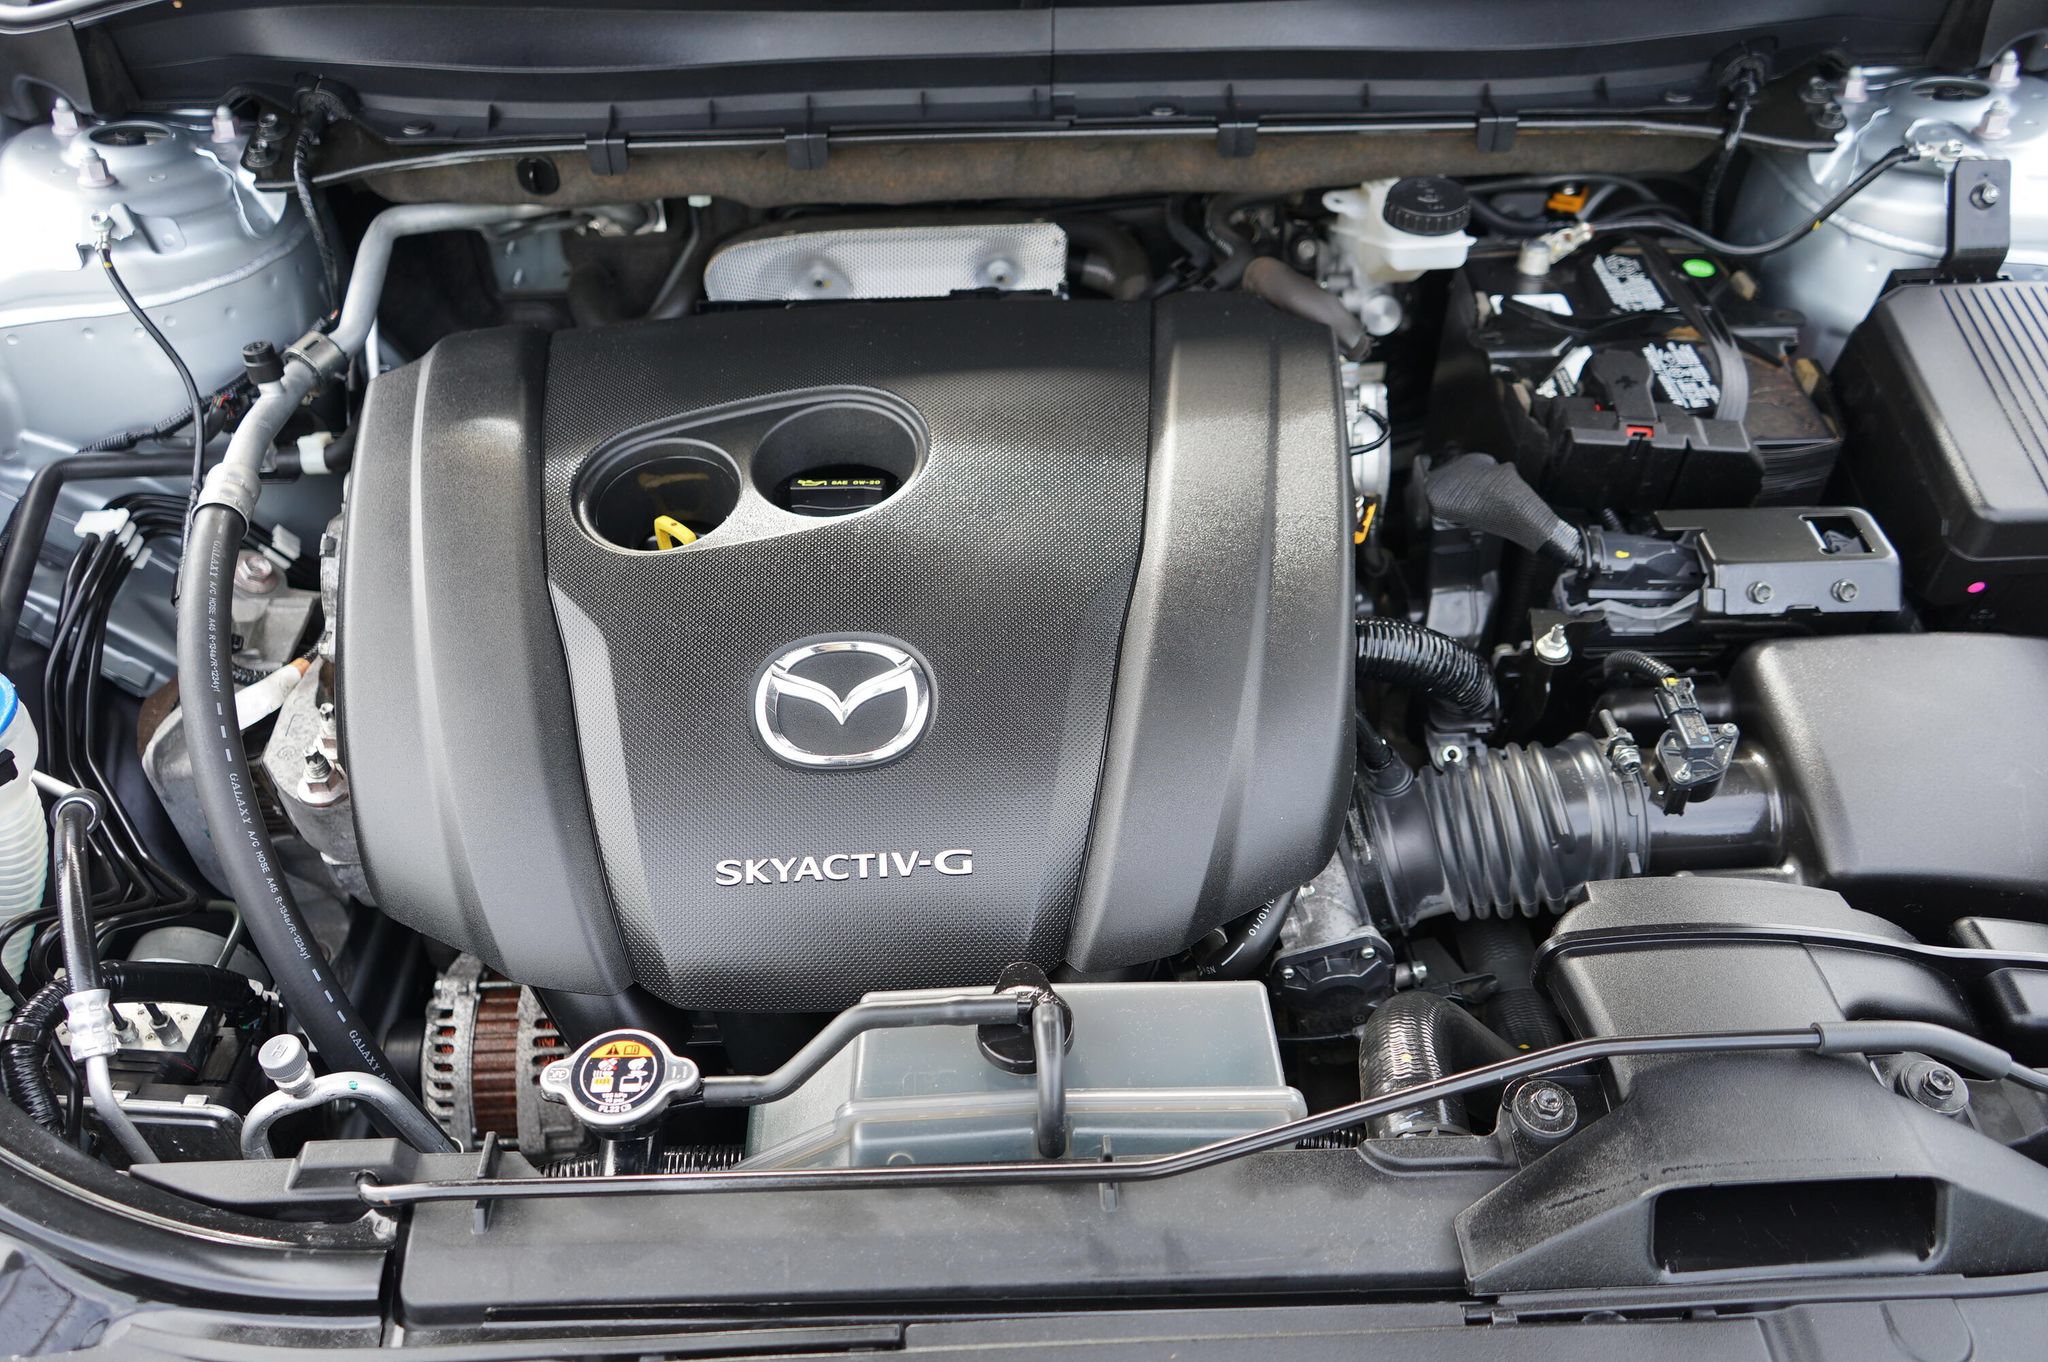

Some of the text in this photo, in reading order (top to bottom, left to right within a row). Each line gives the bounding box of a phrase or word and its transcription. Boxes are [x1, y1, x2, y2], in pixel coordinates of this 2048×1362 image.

[210, 540, 222, 580] GALAXY
[208, 596, 217, 615] HOSE
[209, 582, 217, 594] A/C
[208, 617, 216, 632] A45
[229, 773, 311, 960] GALAXY A/C HOSE A45 R-134a/R-1234yf
[715, 849, 973, 886] SKYACTIV-G
[349, 1030, 380, 1071] GALAXY
